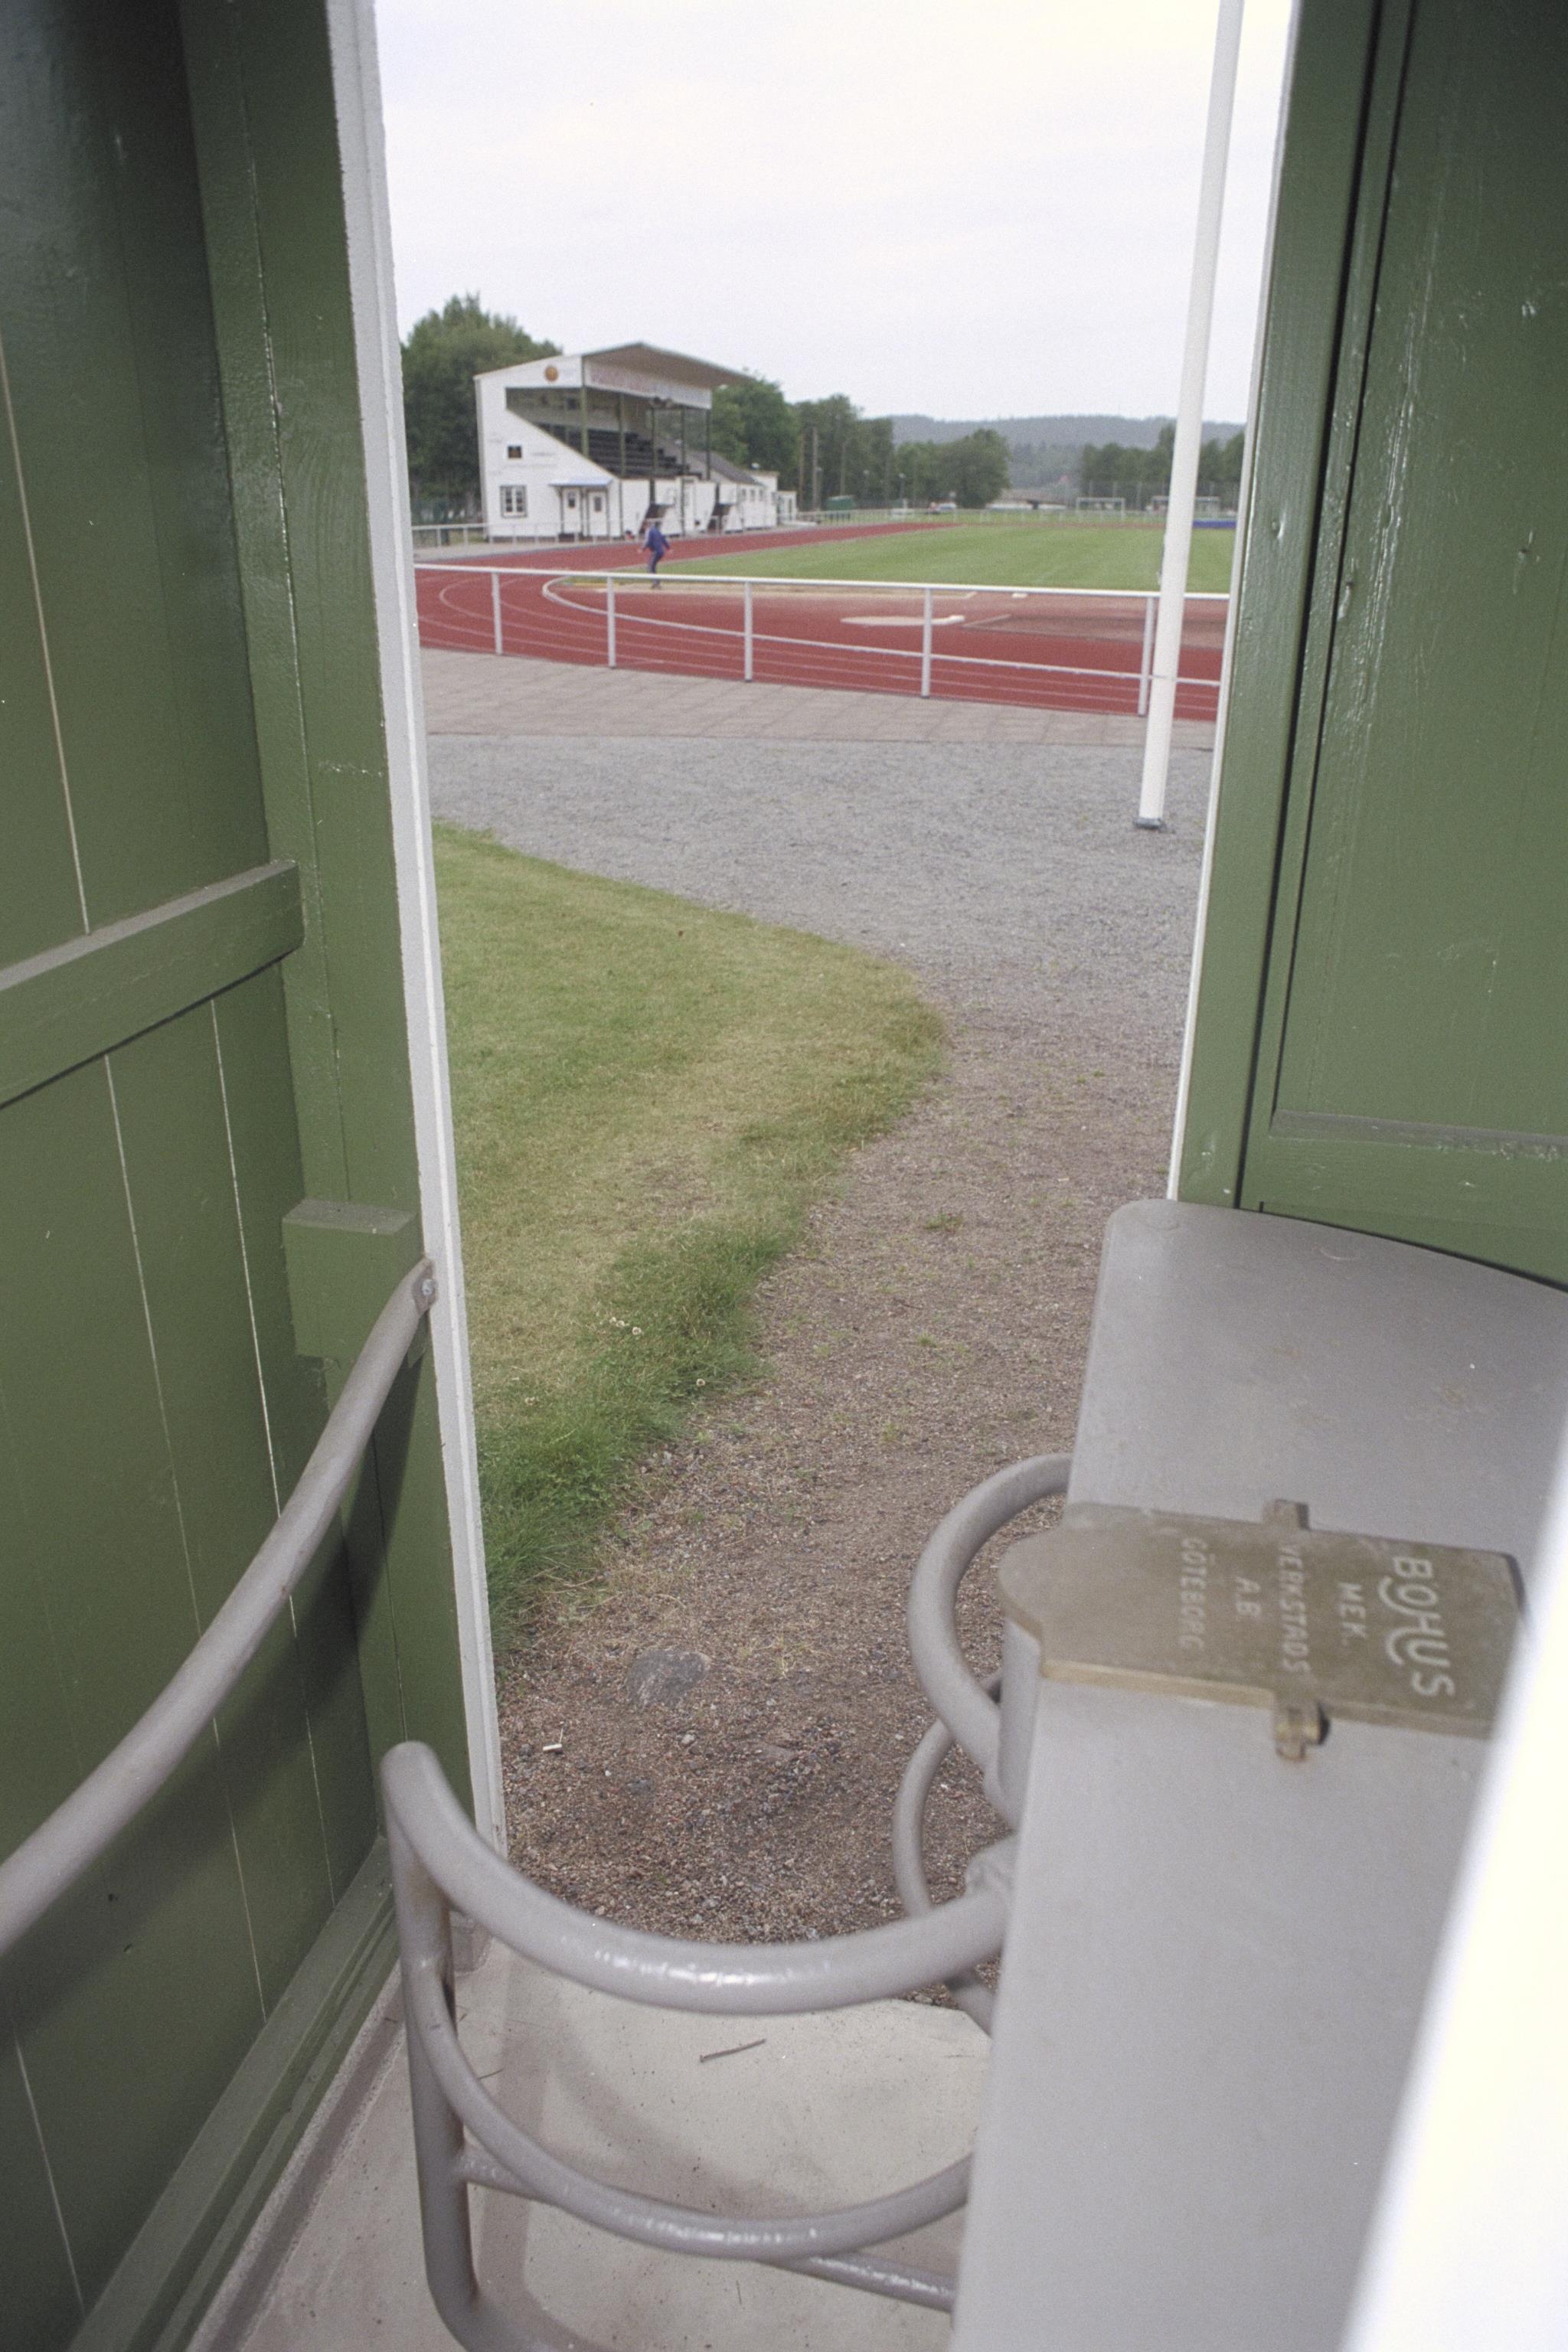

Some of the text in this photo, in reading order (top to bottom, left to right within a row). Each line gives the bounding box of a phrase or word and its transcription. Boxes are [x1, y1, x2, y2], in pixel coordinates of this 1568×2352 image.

[1178, 1537, 1216, 1651] GÖTEBORG
[1279, 1540, 1311, 1673] VERKSTADS
[1338, 1582, 1367, 1647] MEK.
[1377, 1555, 1455, 1697] BOHUS
